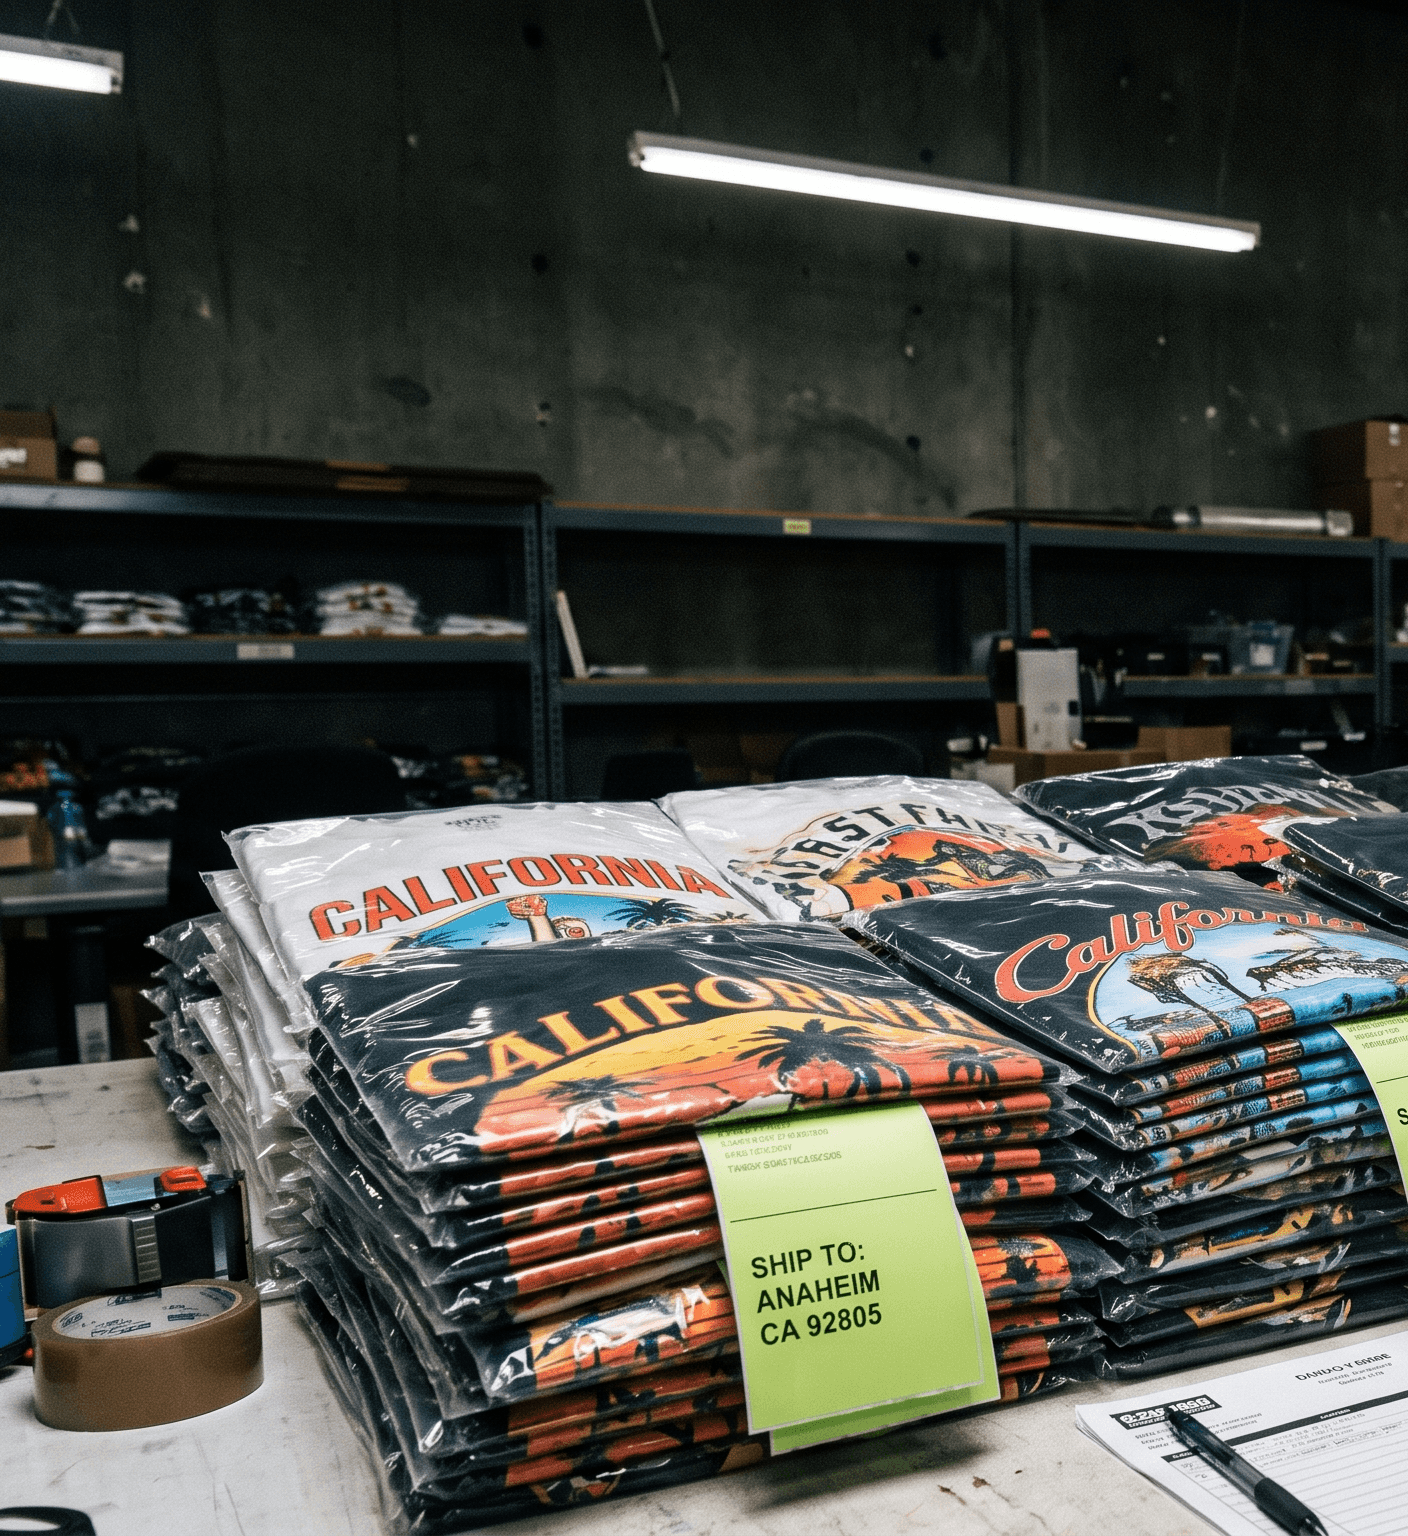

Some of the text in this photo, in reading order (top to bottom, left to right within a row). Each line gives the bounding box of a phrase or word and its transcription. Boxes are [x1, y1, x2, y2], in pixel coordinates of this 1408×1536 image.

[308, 853, 731, 941] CALIFORNIA
[994, 901, 1369, 1003] California
[751, 1240, 865, 1280] SHIP TO:
[756, 1269, 881, 1314] ANAHEIM
[760, 1302, 883, 1346] CA 92805
